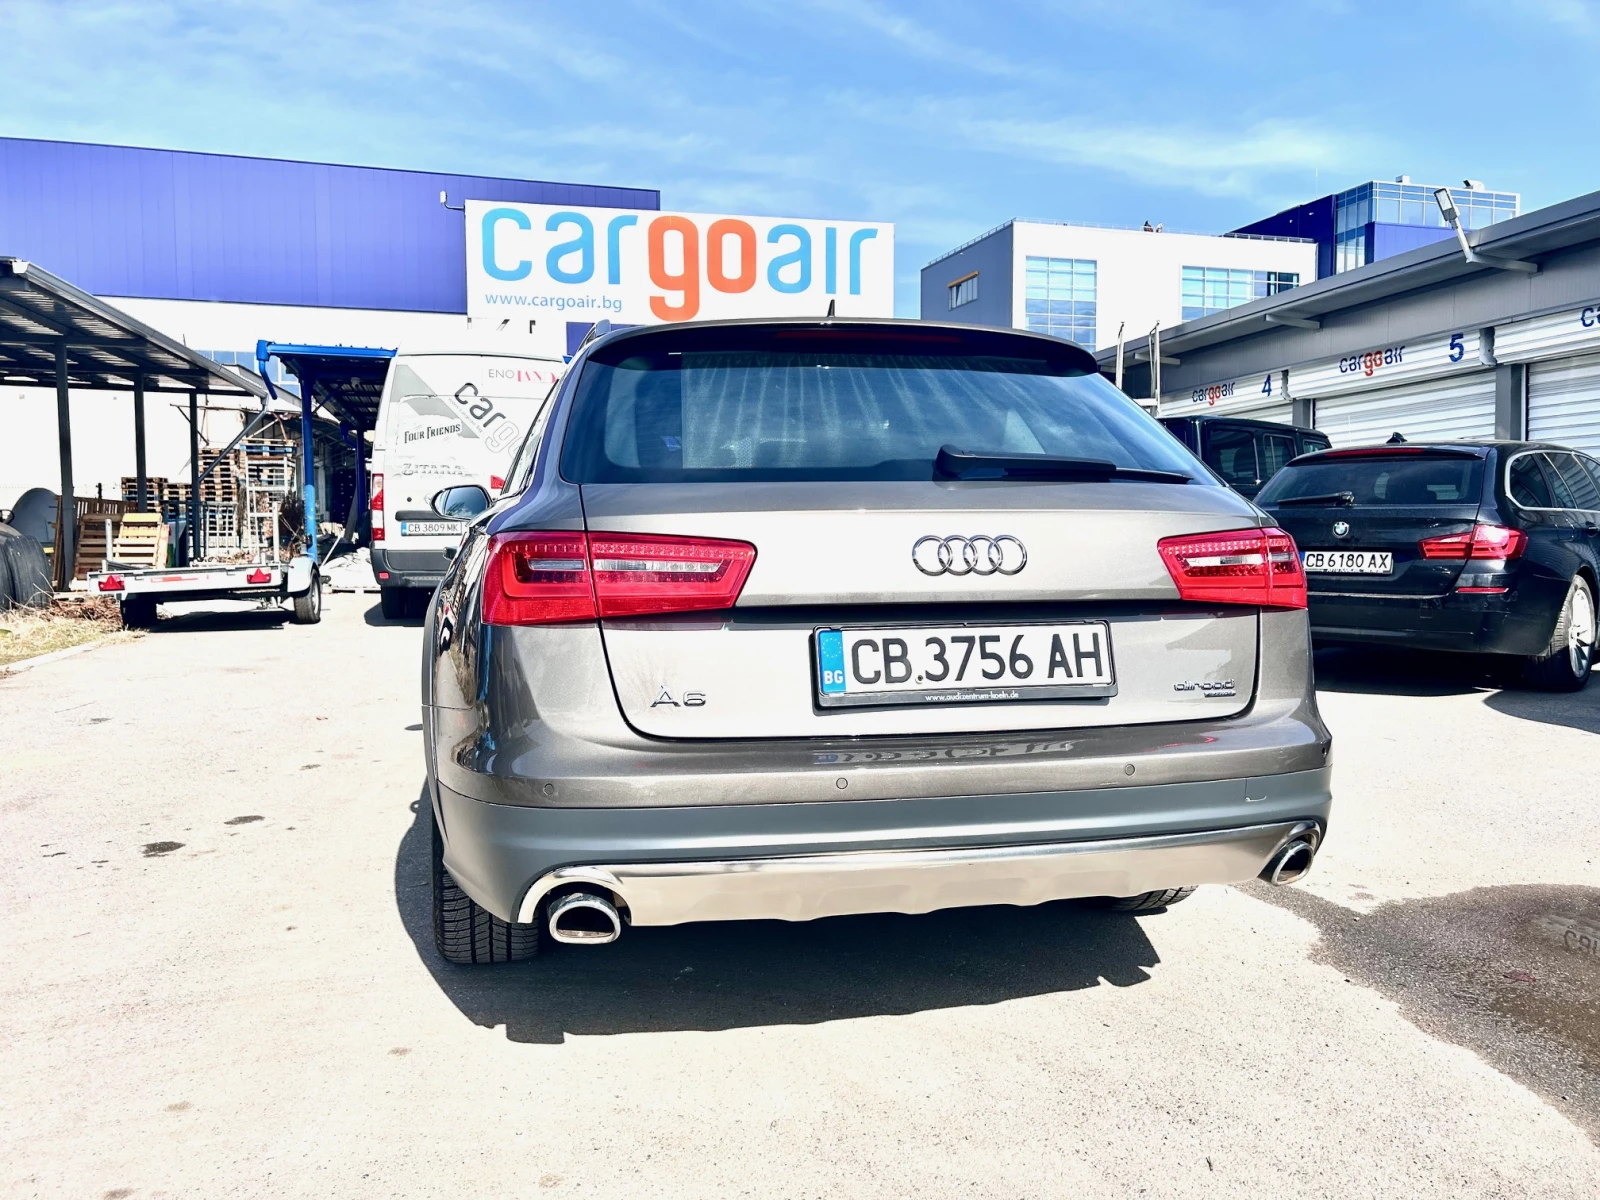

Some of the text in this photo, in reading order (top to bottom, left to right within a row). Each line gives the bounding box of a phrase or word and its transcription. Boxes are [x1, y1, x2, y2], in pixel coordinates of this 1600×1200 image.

[481, 207, 878, 323] cargoair
[485, 294, 622, 312] www.cargoair.bg
[1338, 333, 1465, 376] cargoair 5
[1191, 374, 1273, 406] cargoair 4
[408, 523, 421, 532] CB
[422, 523, 446, 532] 3809
[1305, 553, 1389, 569] CB 6180 AX
[851, 632, 1103, 685] CB 3756 AH
[824, 670, 844, 684] BG
[650, 685, 706, 707] A6
[925, 690, 1019, 701] www.audizentrum-koeln.de
